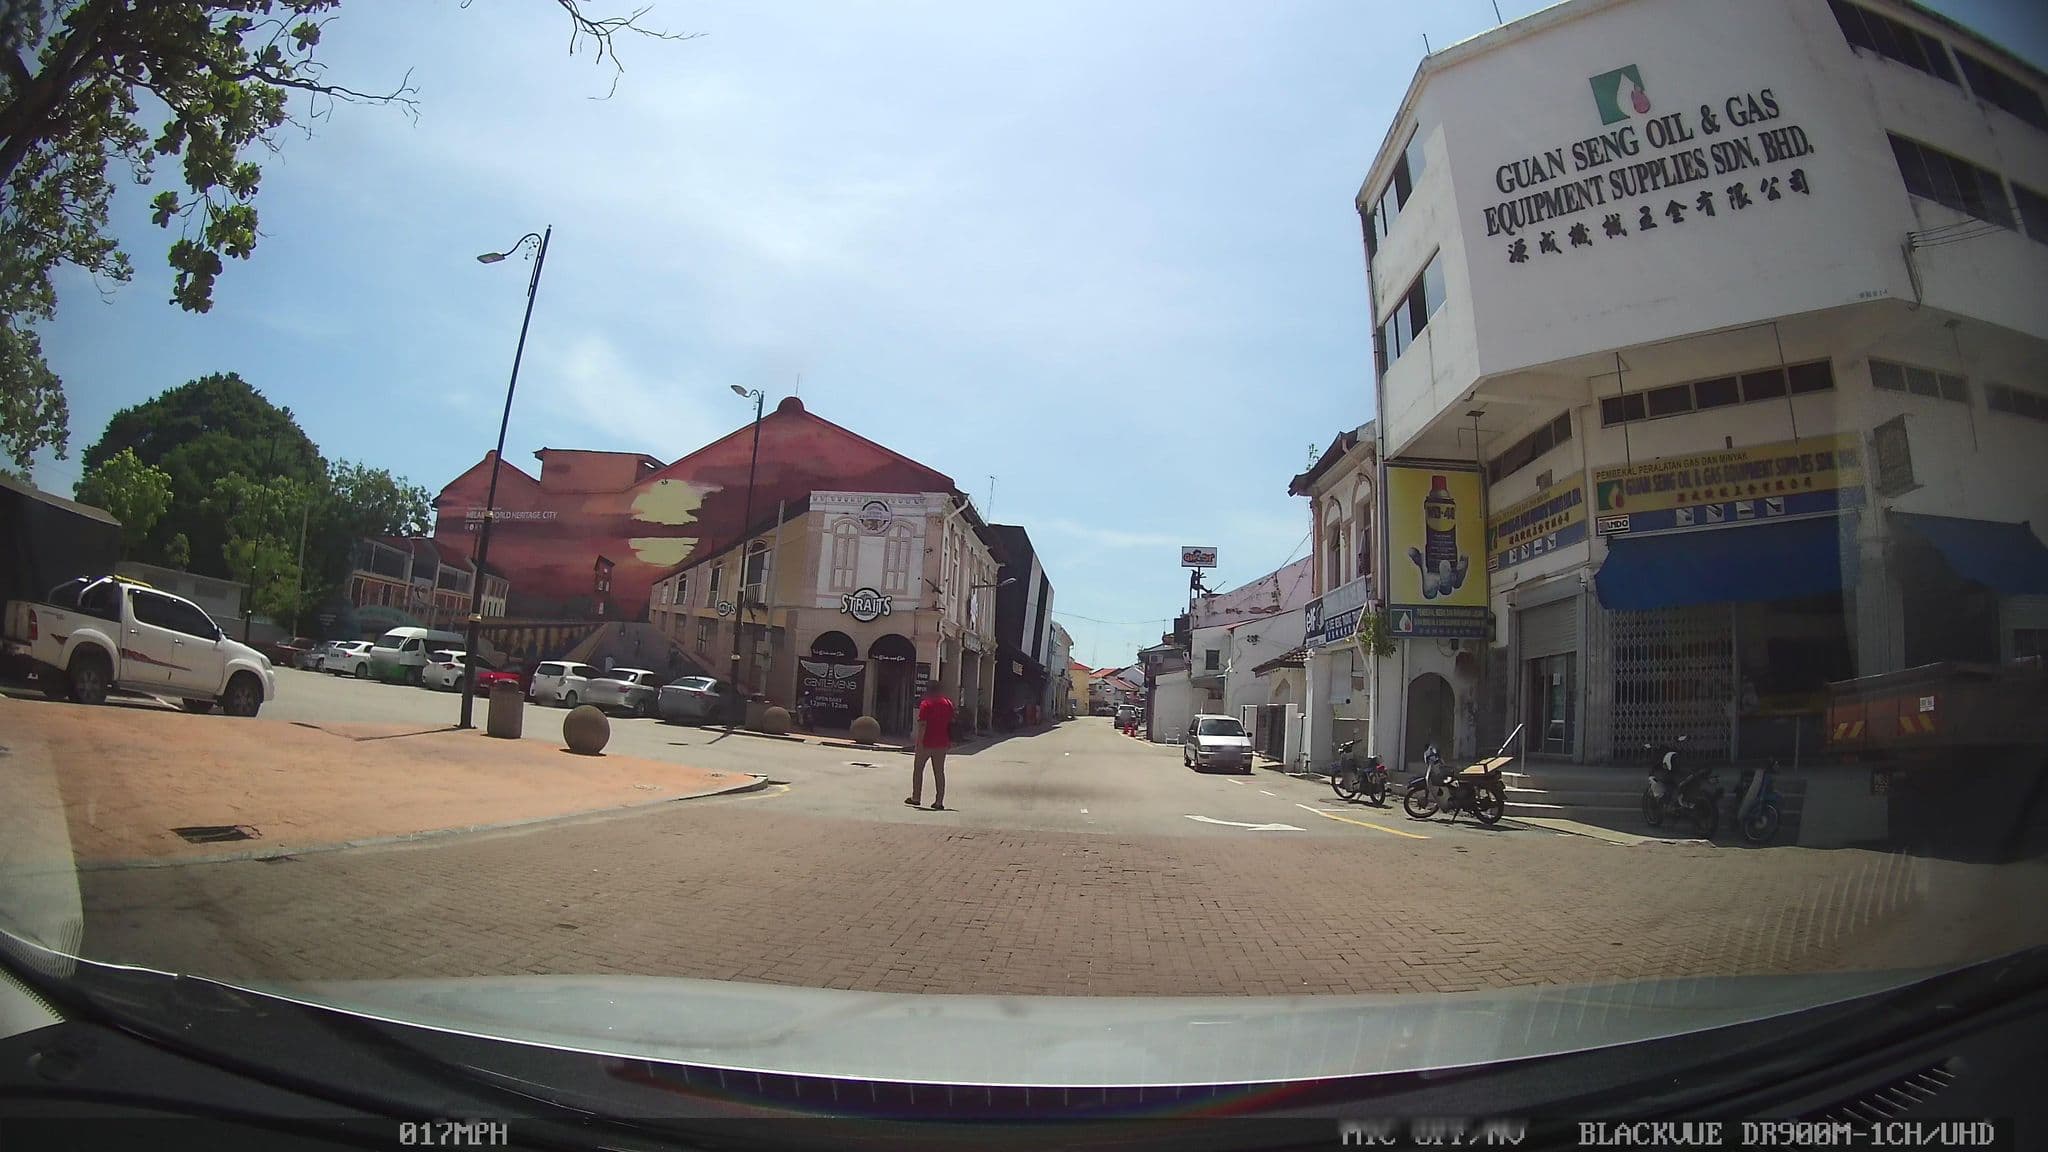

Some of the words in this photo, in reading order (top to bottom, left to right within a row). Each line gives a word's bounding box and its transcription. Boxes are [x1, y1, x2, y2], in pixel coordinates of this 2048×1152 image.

[1496, 148, 1566, 193] GUAN
[1572, 126, 1640, 171] SENG
[1646, 112, 1694, 148] OIL
[1701, 105, 1720, 135] &
[1725, 88, 1780, 127] GAS
[1483, 175, 1607, 237] EQUIPMENT
[1608, 147, 1709, 200] SUPPLIES
[1710, 136, 1760, 175] SDN.
[1758, 125, 1815, 163] BHD.
[1638, 461, 1682, 475] PERALATAN
[1683, 457, 1700, 469] GAS
[491, 511, 511, 520] ORLD
[542, 511, 559, 520] CITY
[842, 594, 891, 616] STRAITS
